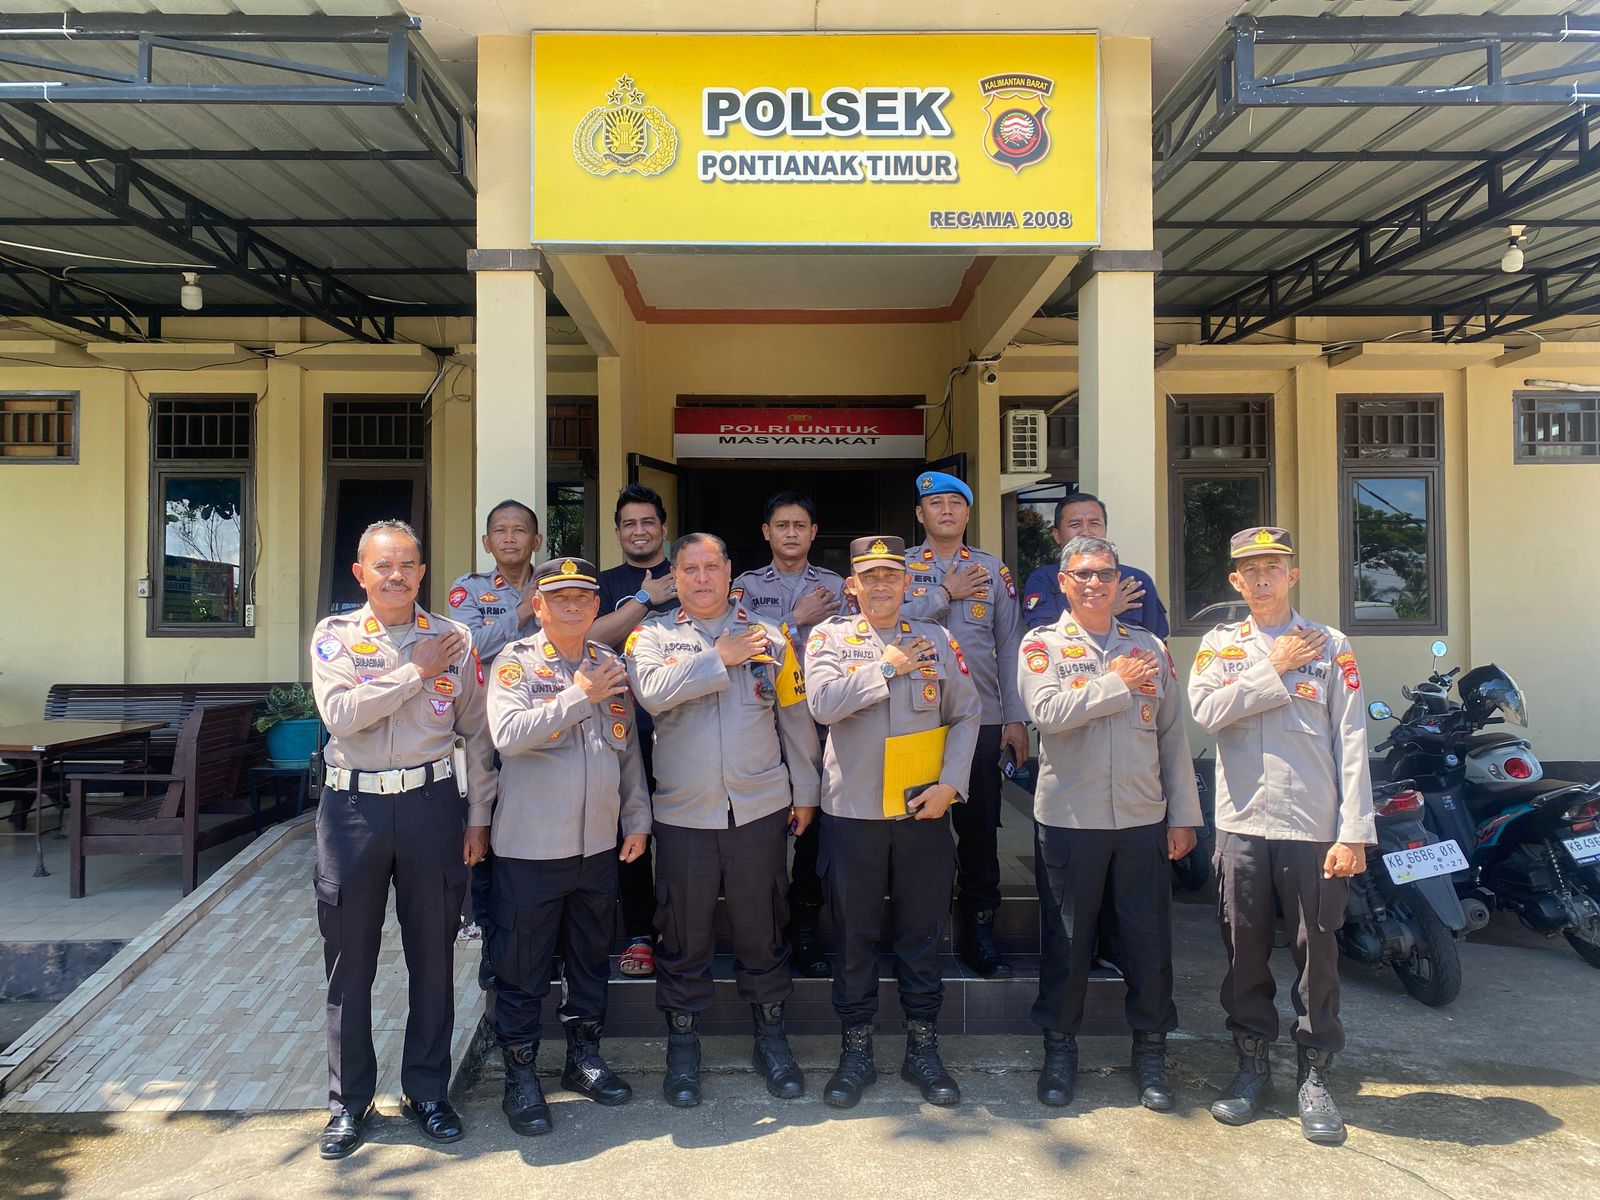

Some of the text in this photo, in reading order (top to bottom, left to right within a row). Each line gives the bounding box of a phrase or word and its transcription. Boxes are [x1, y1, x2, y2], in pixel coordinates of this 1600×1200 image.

[984, 77, 1049, 90] KALIMANTAN BARAT
[705, 90, 946, 133] POLSEK
[702, 155, 953, 177] PONTIANAK TIMUR
[930, 211, 1072, 228] REGAMA 2008
[719, 424, 880, 434] POLRI UNTUK
[718, 436, 881, 446] MASYARAKAT
[1059, 662, 1097, 675] SUGENG
[1297, 664, 1327, 680] OLRI
[1568, 836, 1600, 853] KB 496
[1387, 854, 1404, 868] KB
[1406, 848, 1436, 864] 6686
